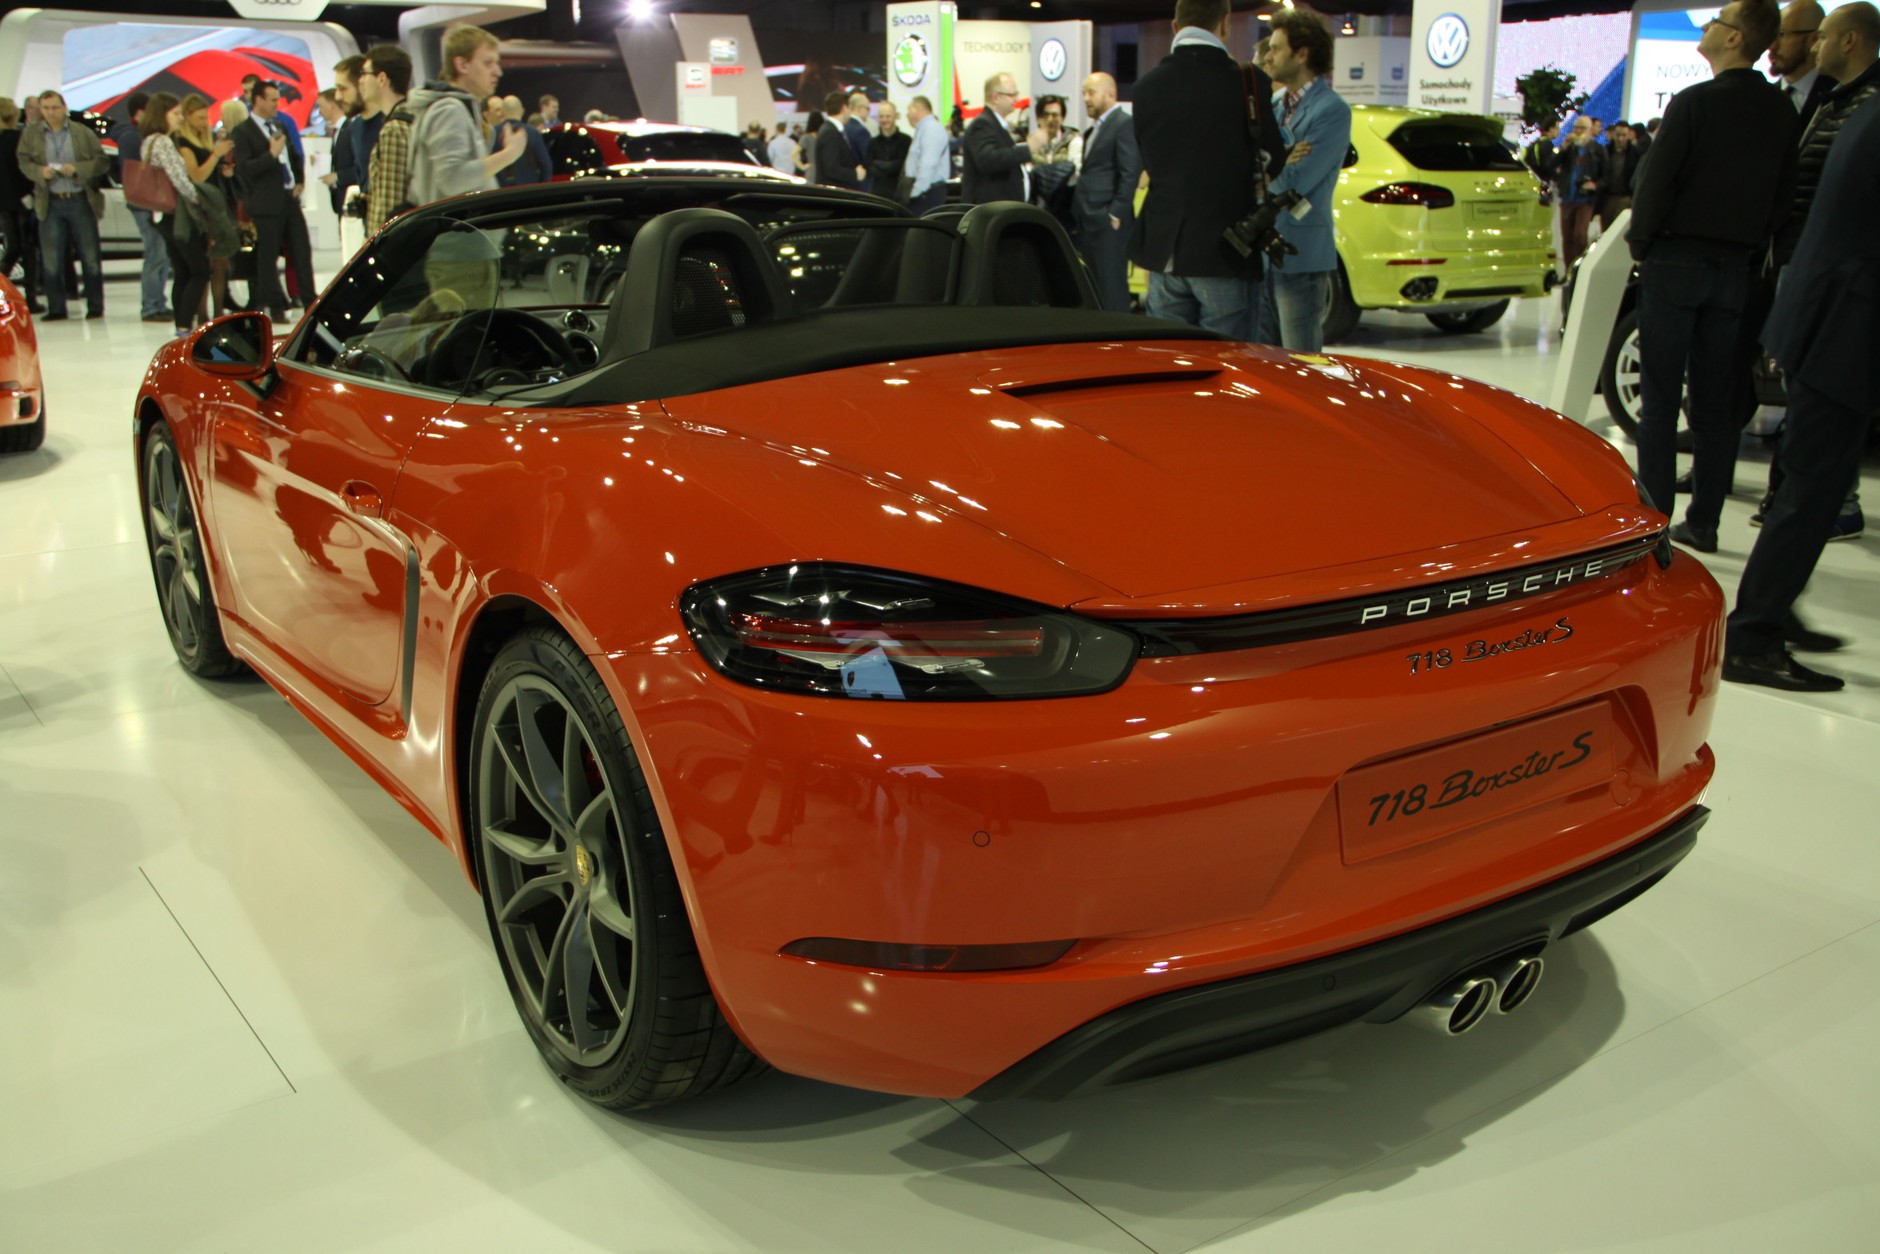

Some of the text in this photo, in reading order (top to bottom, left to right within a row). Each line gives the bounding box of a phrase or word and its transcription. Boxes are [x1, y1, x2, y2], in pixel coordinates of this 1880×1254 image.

[1419, 78, 1472, 91] Samochody
[1657, 63, 1710, 79] NOWY
[1421, 94, 1468, 106] Użytkowe
[1361, 560, 1603, 625] PORSCHE
[1407, 648, 1453, 675] 718
[1461, 627, 1553, 663] Boxster
[1368, 731, 1593, 826] 718 Boxster S
